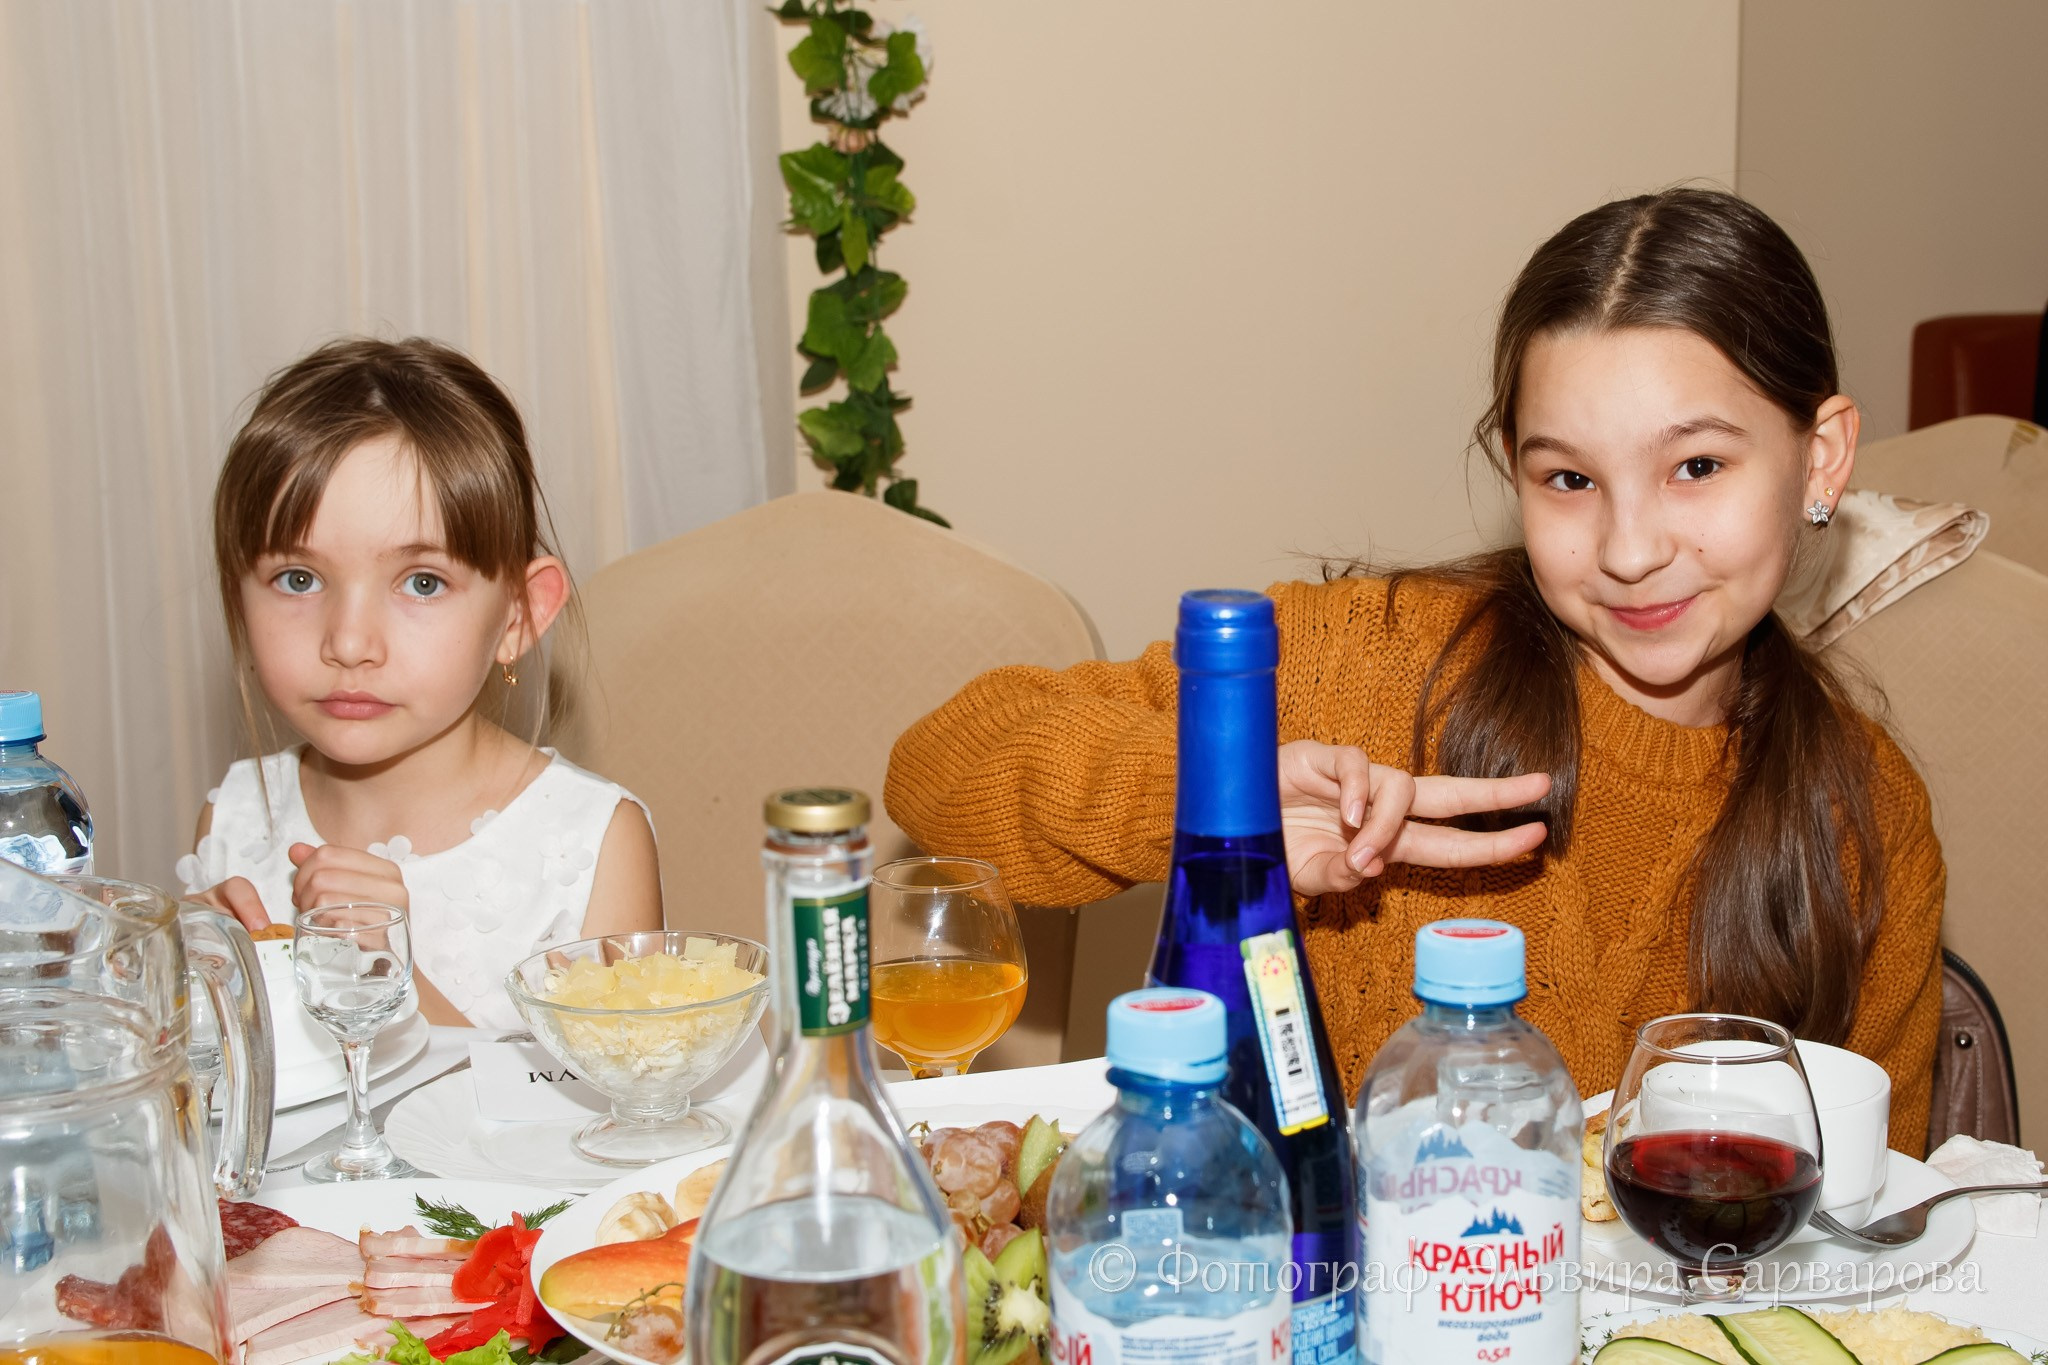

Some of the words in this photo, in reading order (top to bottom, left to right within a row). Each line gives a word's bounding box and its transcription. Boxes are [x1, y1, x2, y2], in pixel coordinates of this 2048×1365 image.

[1409, 1222, 1565, 1275] КРАСНЫЙ
[1440, 1276, 1543, 1313] КЛЮЧ
[1476, 1329, 1510, 1342] вода
